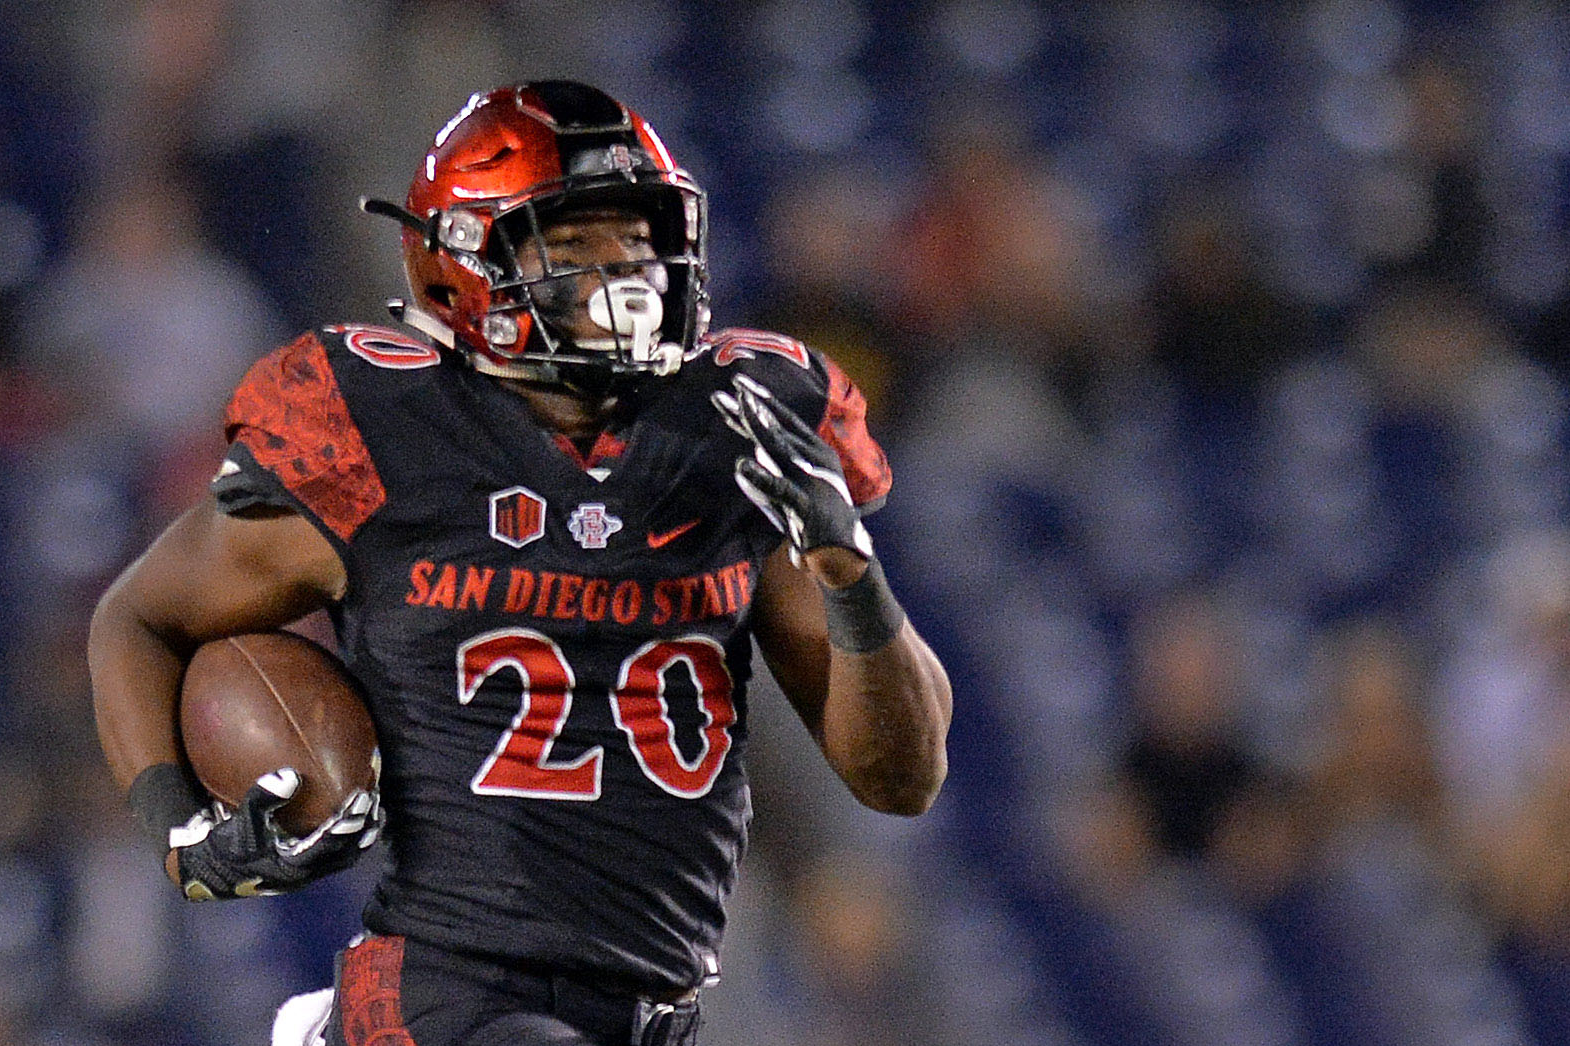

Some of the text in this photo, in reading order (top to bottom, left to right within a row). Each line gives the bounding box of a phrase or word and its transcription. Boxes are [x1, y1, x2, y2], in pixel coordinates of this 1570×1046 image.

[405, 559, 496, 612] SAN
[503, 565, 643, 625] DIEGO
[456, 626, 737, 800] 20
